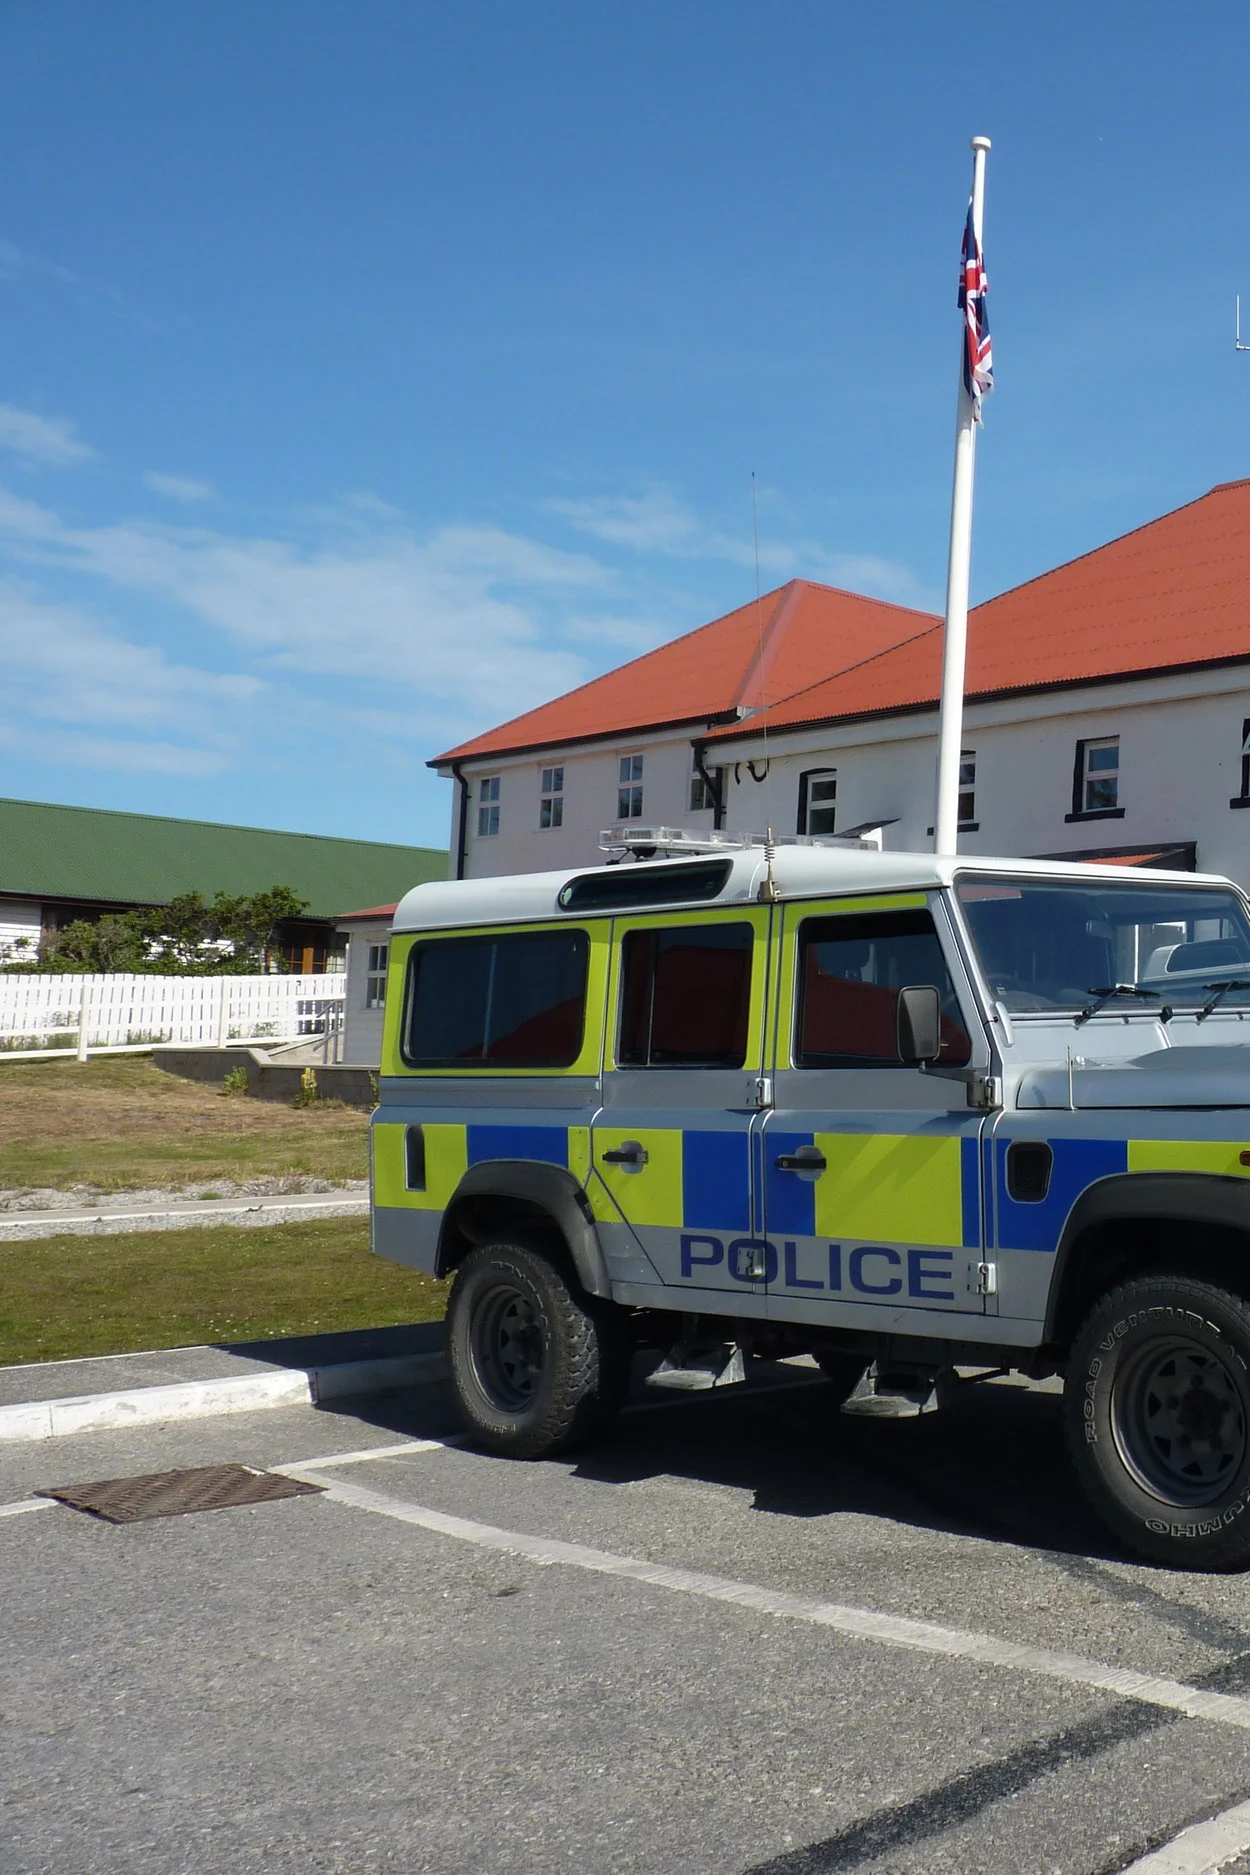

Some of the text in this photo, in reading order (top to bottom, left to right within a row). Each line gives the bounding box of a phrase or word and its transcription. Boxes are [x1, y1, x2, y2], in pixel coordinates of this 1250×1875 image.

[680, 1234, 954, 1300] POLICE
[1084, 1306, 1221, 1443] ROAD VENTUR
